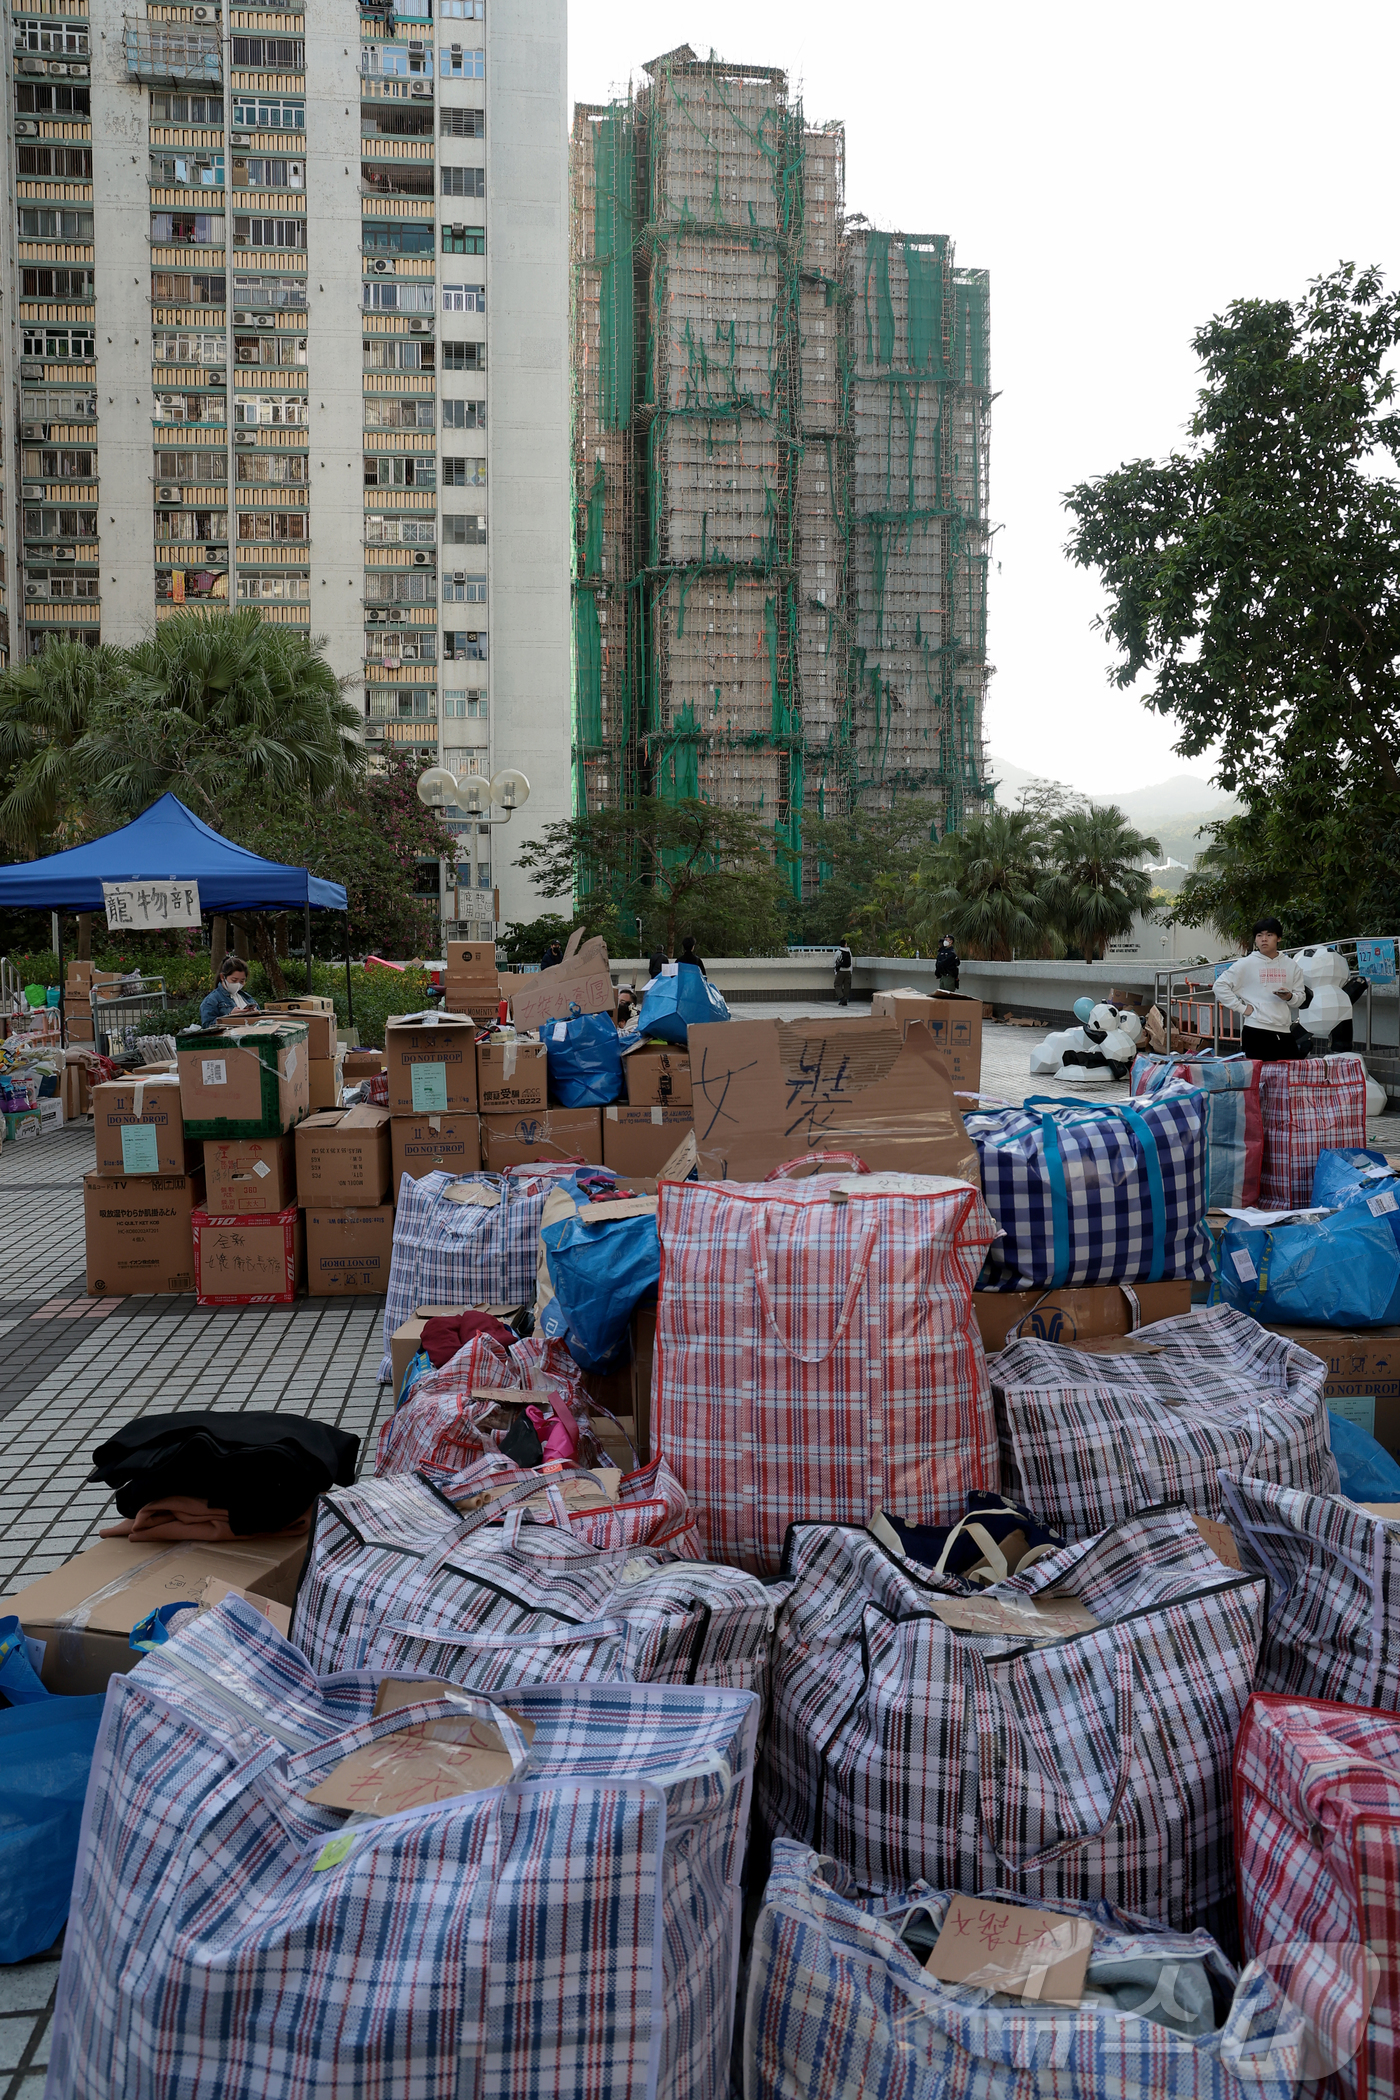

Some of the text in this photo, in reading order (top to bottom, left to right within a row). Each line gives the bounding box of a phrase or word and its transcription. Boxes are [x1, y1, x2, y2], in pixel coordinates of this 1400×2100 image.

[105, 887, 193, 923] 寵物部
[467, 1008, 493, 1016] MOMENTS
[438, 1053, 461, 1061] DROP
[692, 1039, 863, 1148] 女裝
[109, 1116, 122, 1124] DO
[142, 1115, 166, 1123] DROP
[420, 1145, 439, 1153] NOT
[439, 1144, 463, 1152] DROP
[322, 1258, 378, 1268] DO NOT DROP
[1323, 1383, 1399, 1395] O NOT DROP
